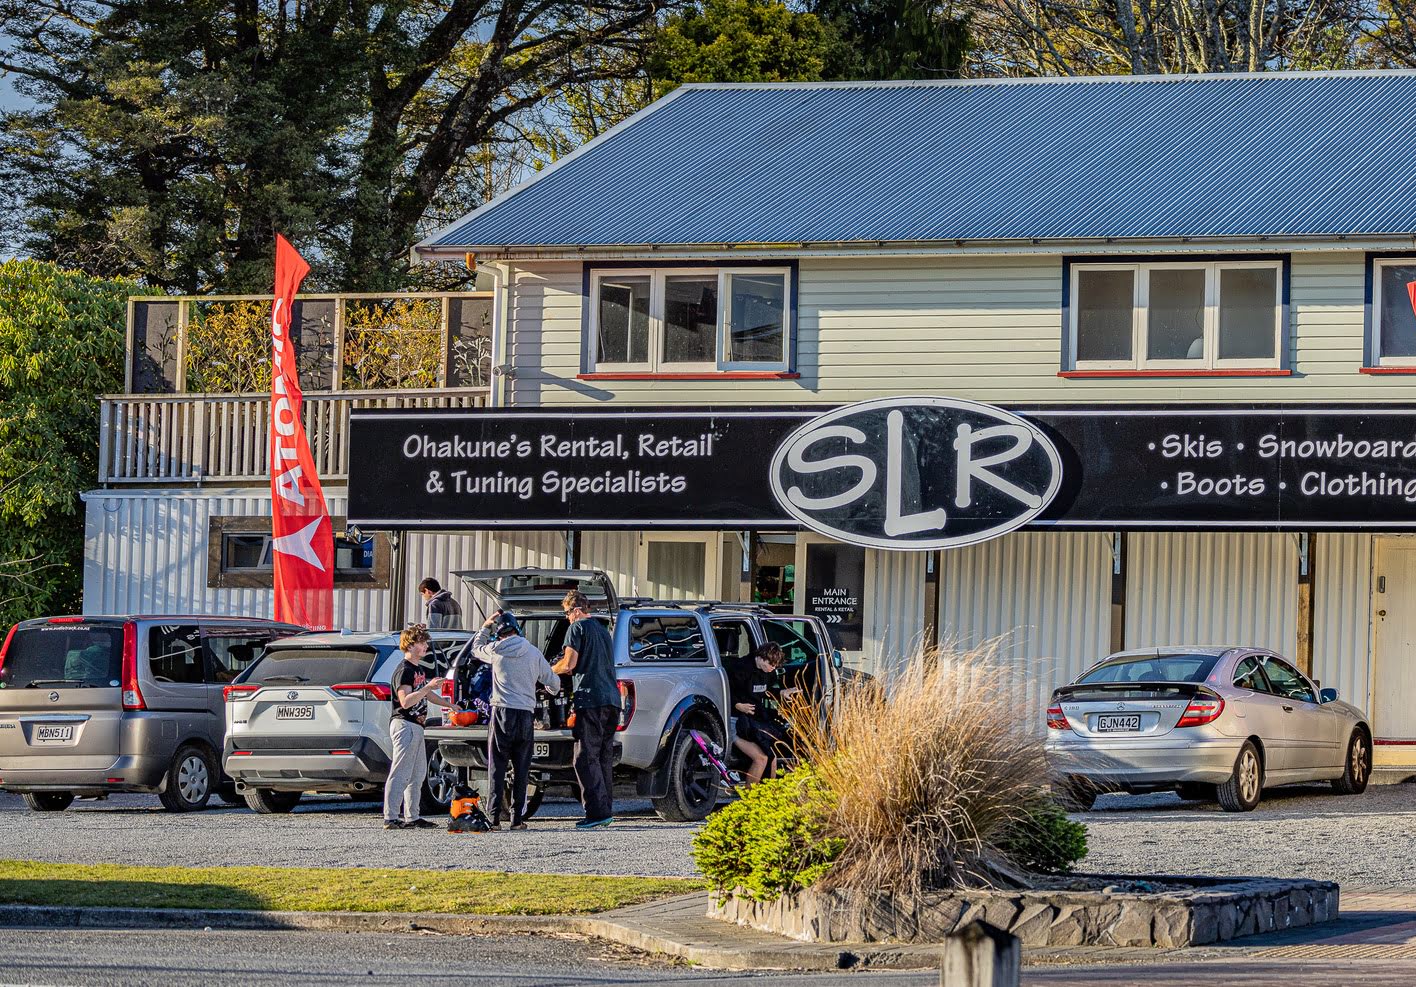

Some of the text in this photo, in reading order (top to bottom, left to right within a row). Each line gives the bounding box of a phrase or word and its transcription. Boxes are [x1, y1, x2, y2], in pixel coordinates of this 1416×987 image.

[539, 433, 630, 460] Rental,
[638, 433, 713, 457] Retail
[1161, 433, 1223, 459] Skis
[787, 409, 1043, 537] SLR
[425, 470, 687, 503] & Tuning Specialists
[1176, 471, 1266, 497] Boots
[812, 596, 858, 605] ENTRANCE
[823, 588, 847, 597] MAIN
[277, 707, 312, 718] MNW395
[1100, 717, 1138, 729] GJN442
[38, 728, 70, 738] MBN511
